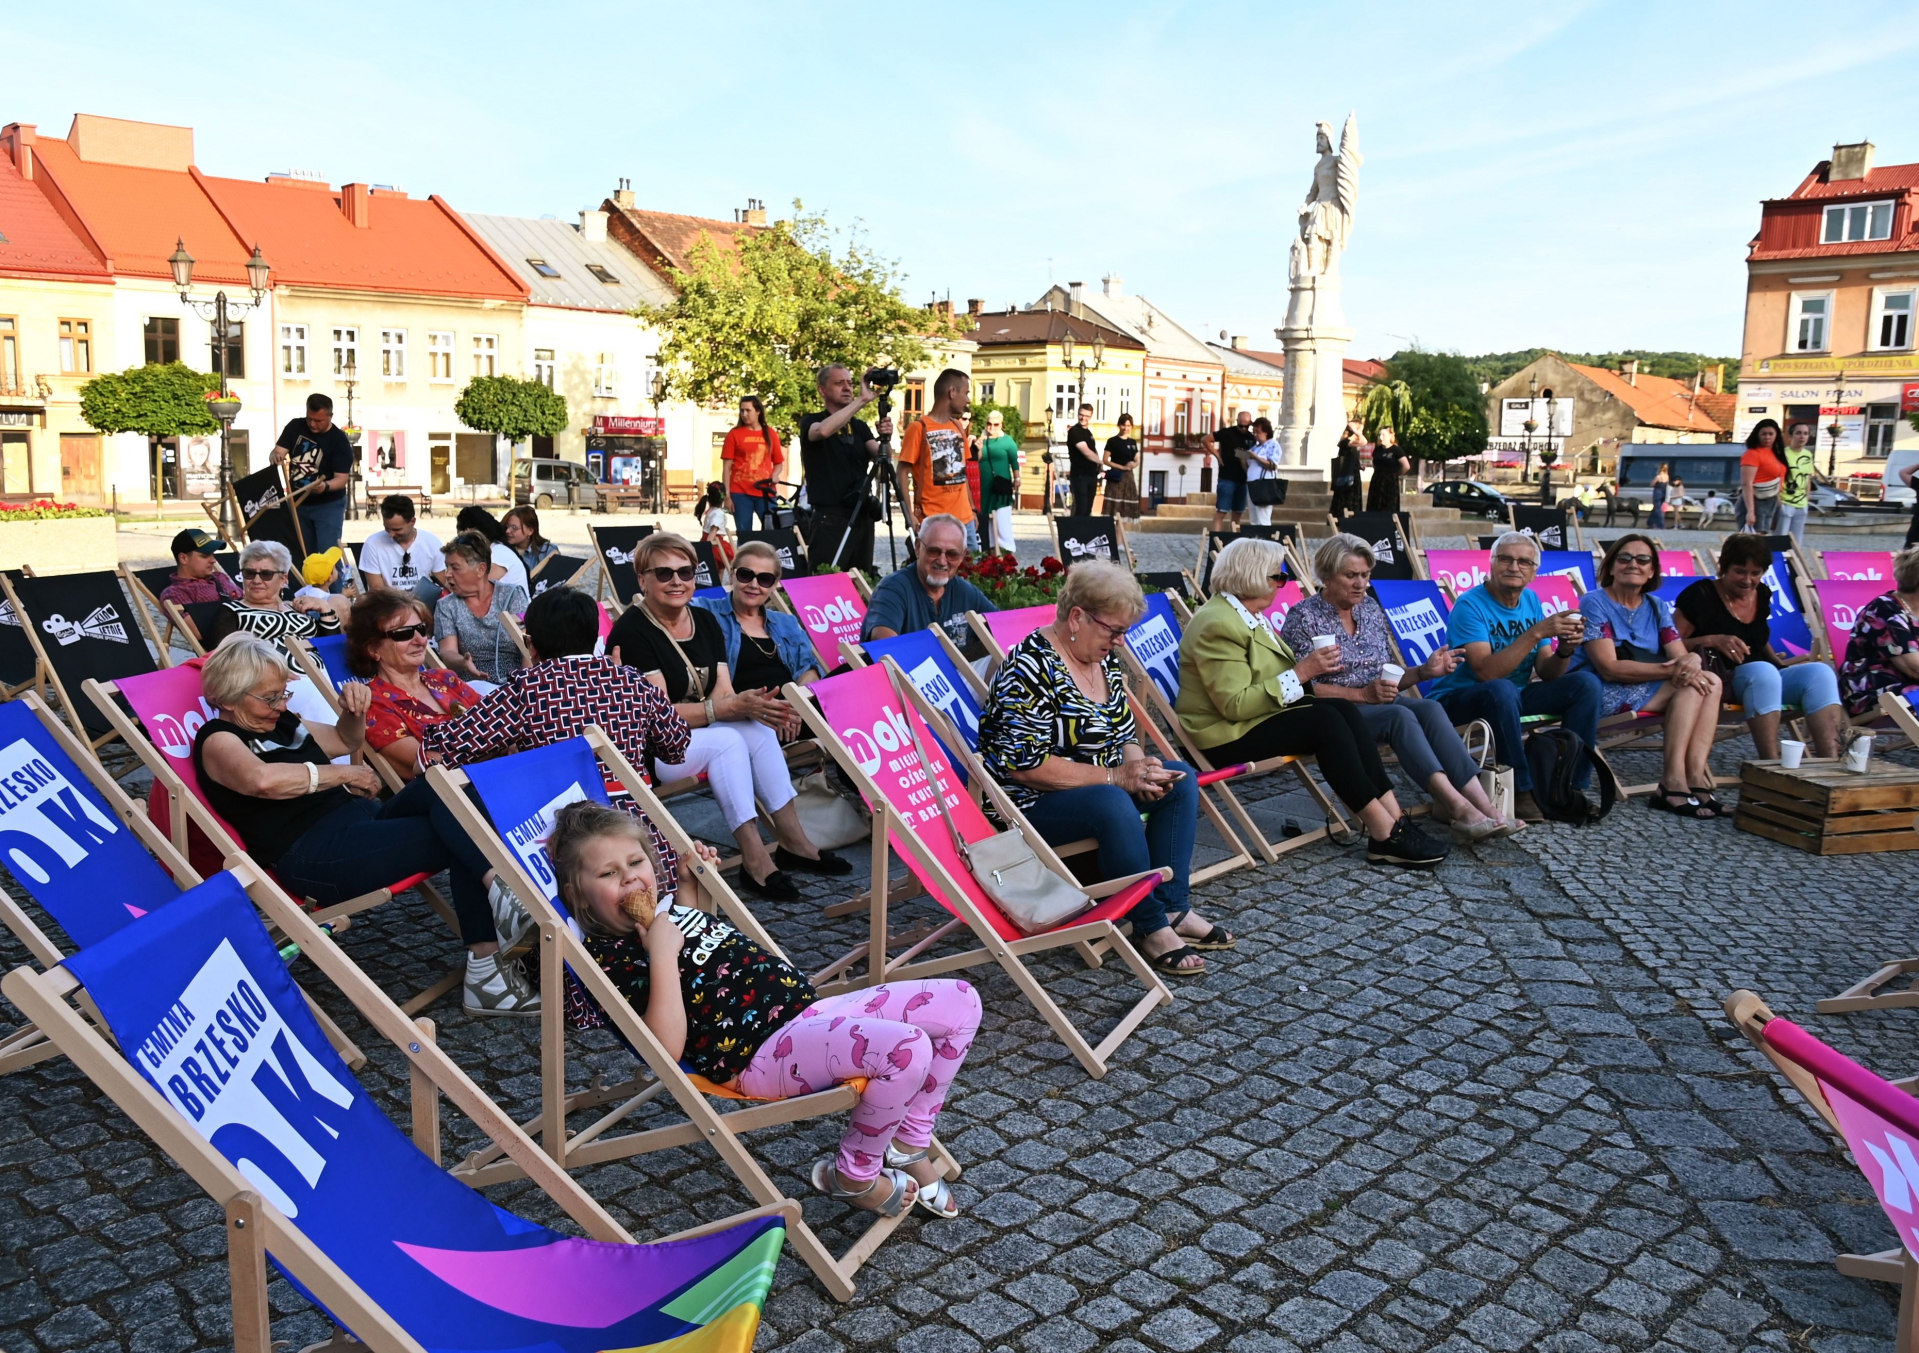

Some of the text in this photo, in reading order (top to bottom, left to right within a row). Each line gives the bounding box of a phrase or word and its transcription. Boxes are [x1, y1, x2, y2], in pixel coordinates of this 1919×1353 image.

[1780, 390, 1819, 399] SALON
[608, 417, 657, 429] Millennium
[1395, 610, 1440, 635] BRZESKO
[1136, 628, 1174, 663] BRZESKO
[898, 759, 945, 790] OŚROEK
[907, 777, 950, 807] KULTRY
[511, 812, 548, 846] GMINA
[144, 998, 197, 1070] GMINA
[167, 978, 268, 1123] BRZESKO
